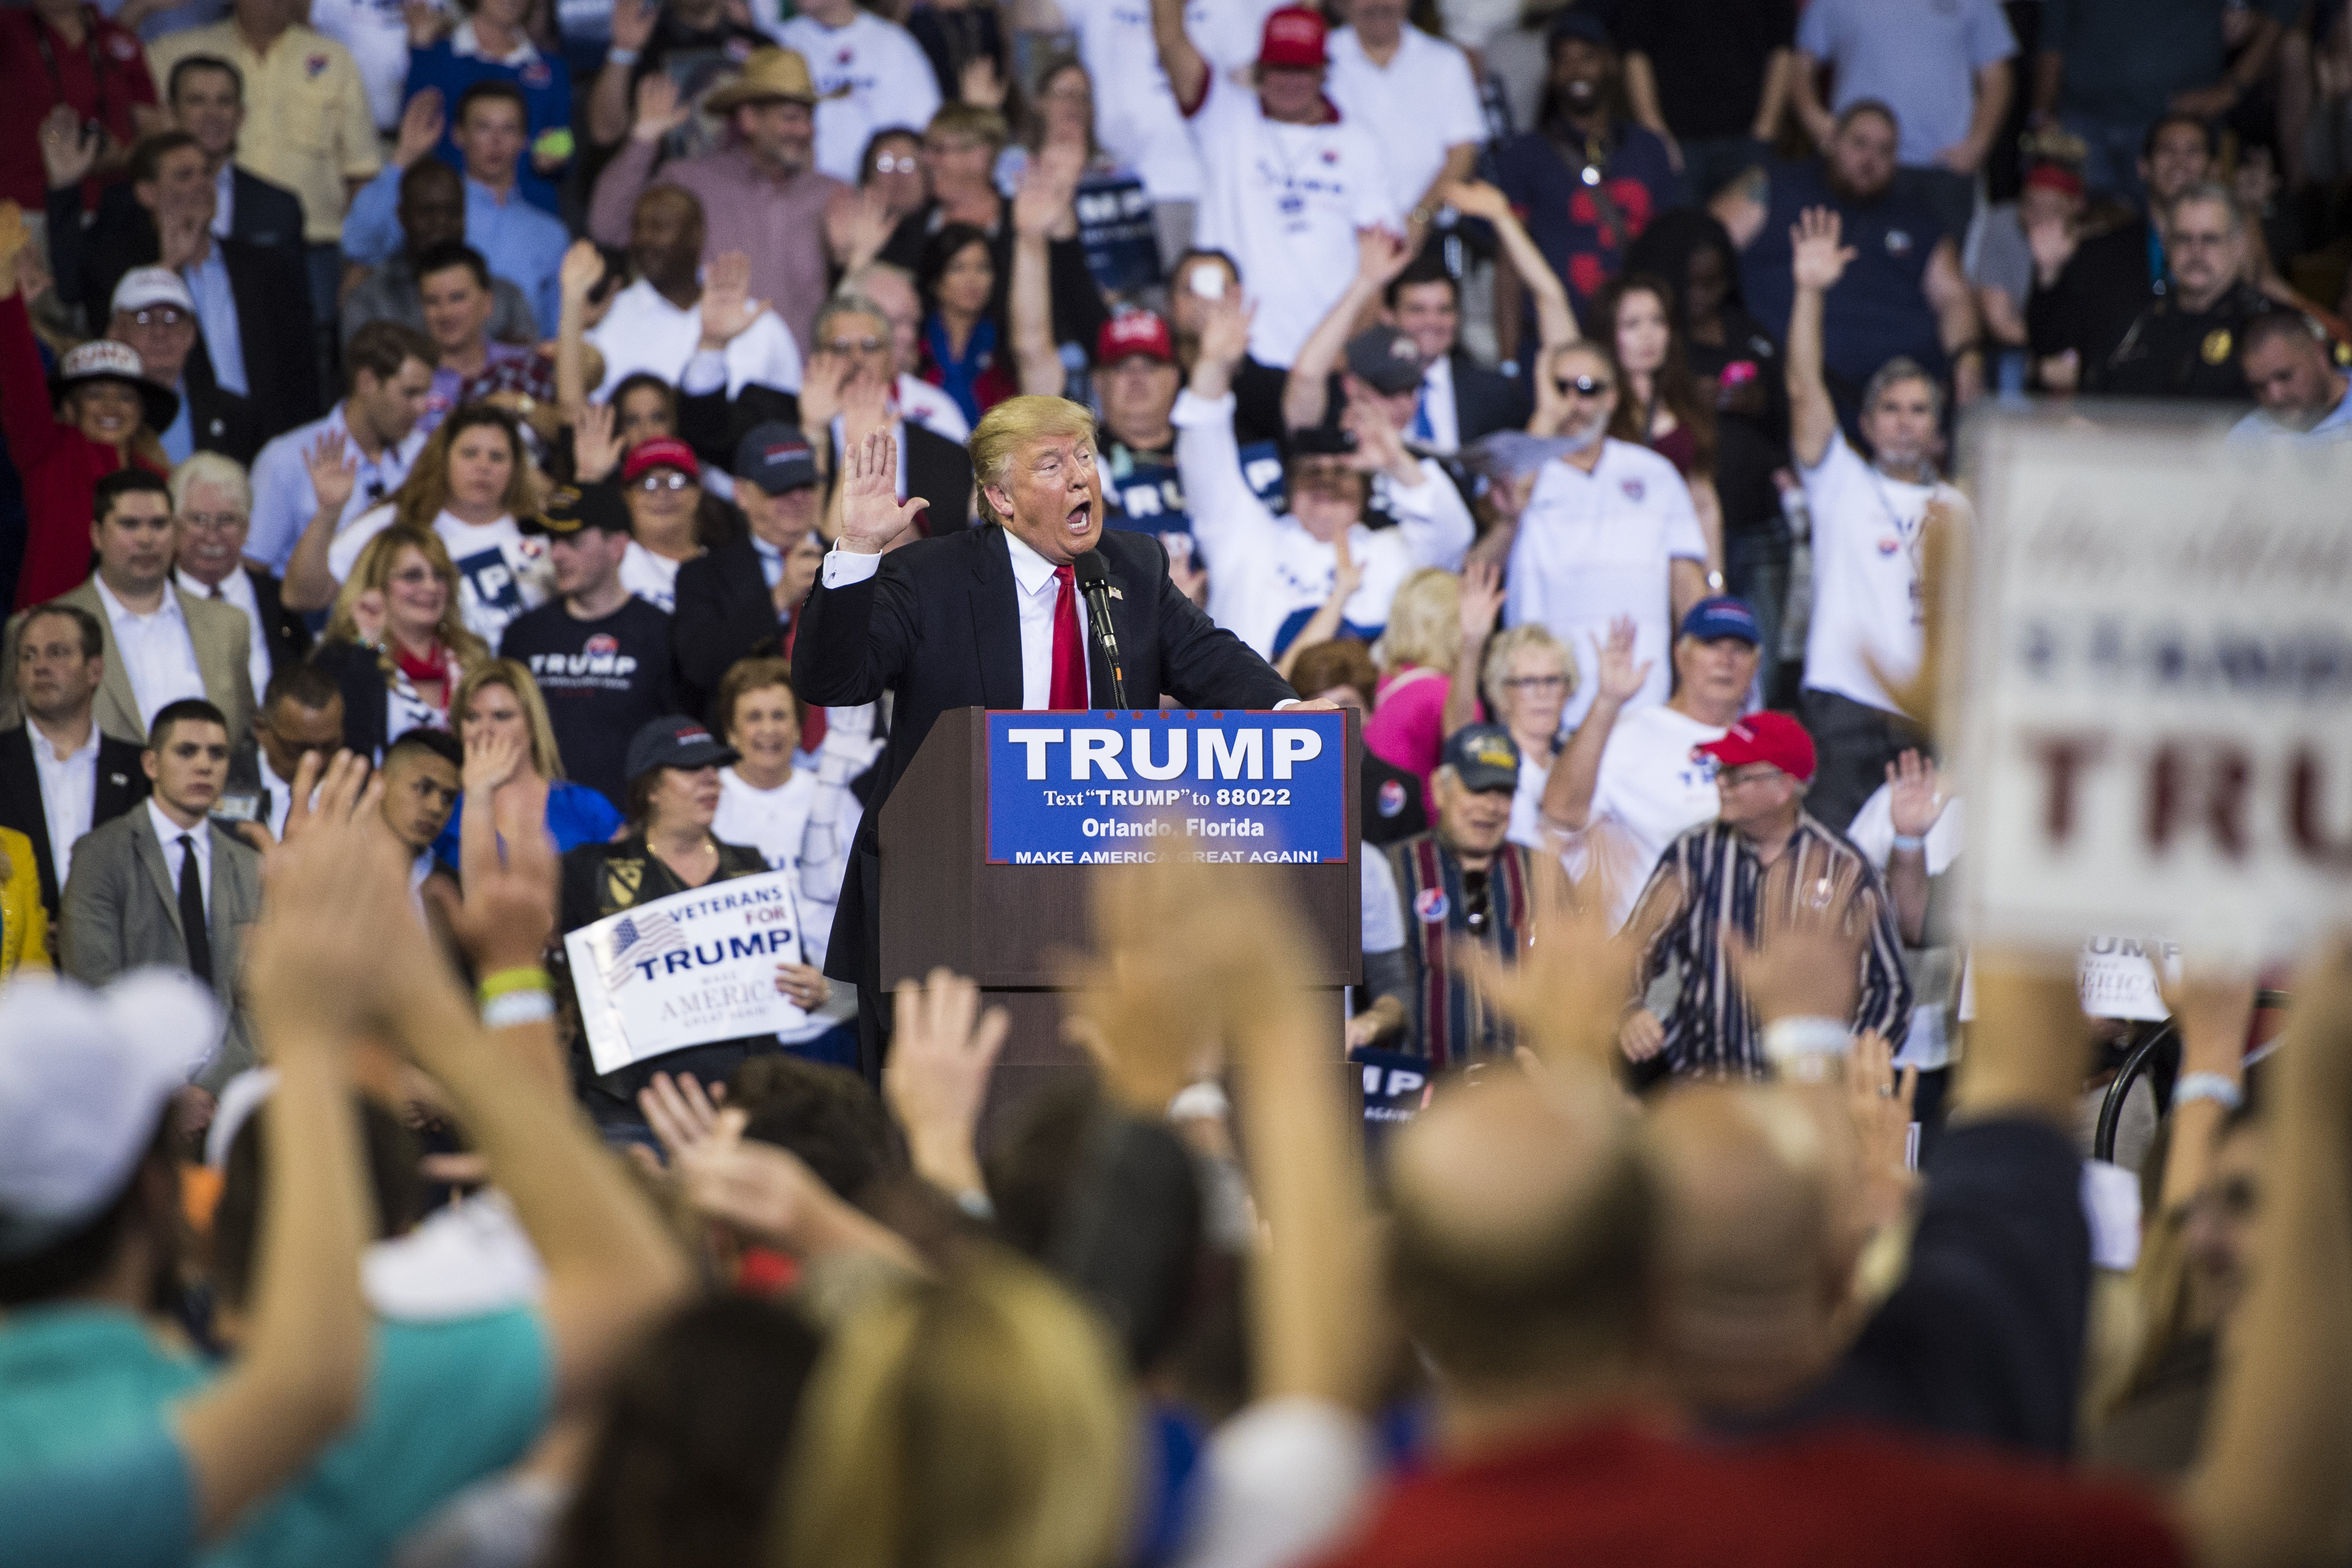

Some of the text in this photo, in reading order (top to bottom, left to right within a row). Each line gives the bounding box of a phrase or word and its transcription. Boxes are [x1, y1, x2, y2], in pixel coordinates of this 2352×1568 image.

[529, 653, 638, 676] TRUMP
[1009, 729, 1322, 780] TRUMP
[1044, 791, 1084, 806] Text
[1192, 792, 1210, 806] to
[1216, 789, 1291, 806] 88022
[1186, 818, 1264, 836] Florida
[1016, 852, 1073, 864] MAKE
[1249, 851, 1318, 863] AGAIN!
[667, 885, 782, 922] VETERANS
[745, 905, 786, 925] FOR
[636, 929, 792, 981] TRUMP
